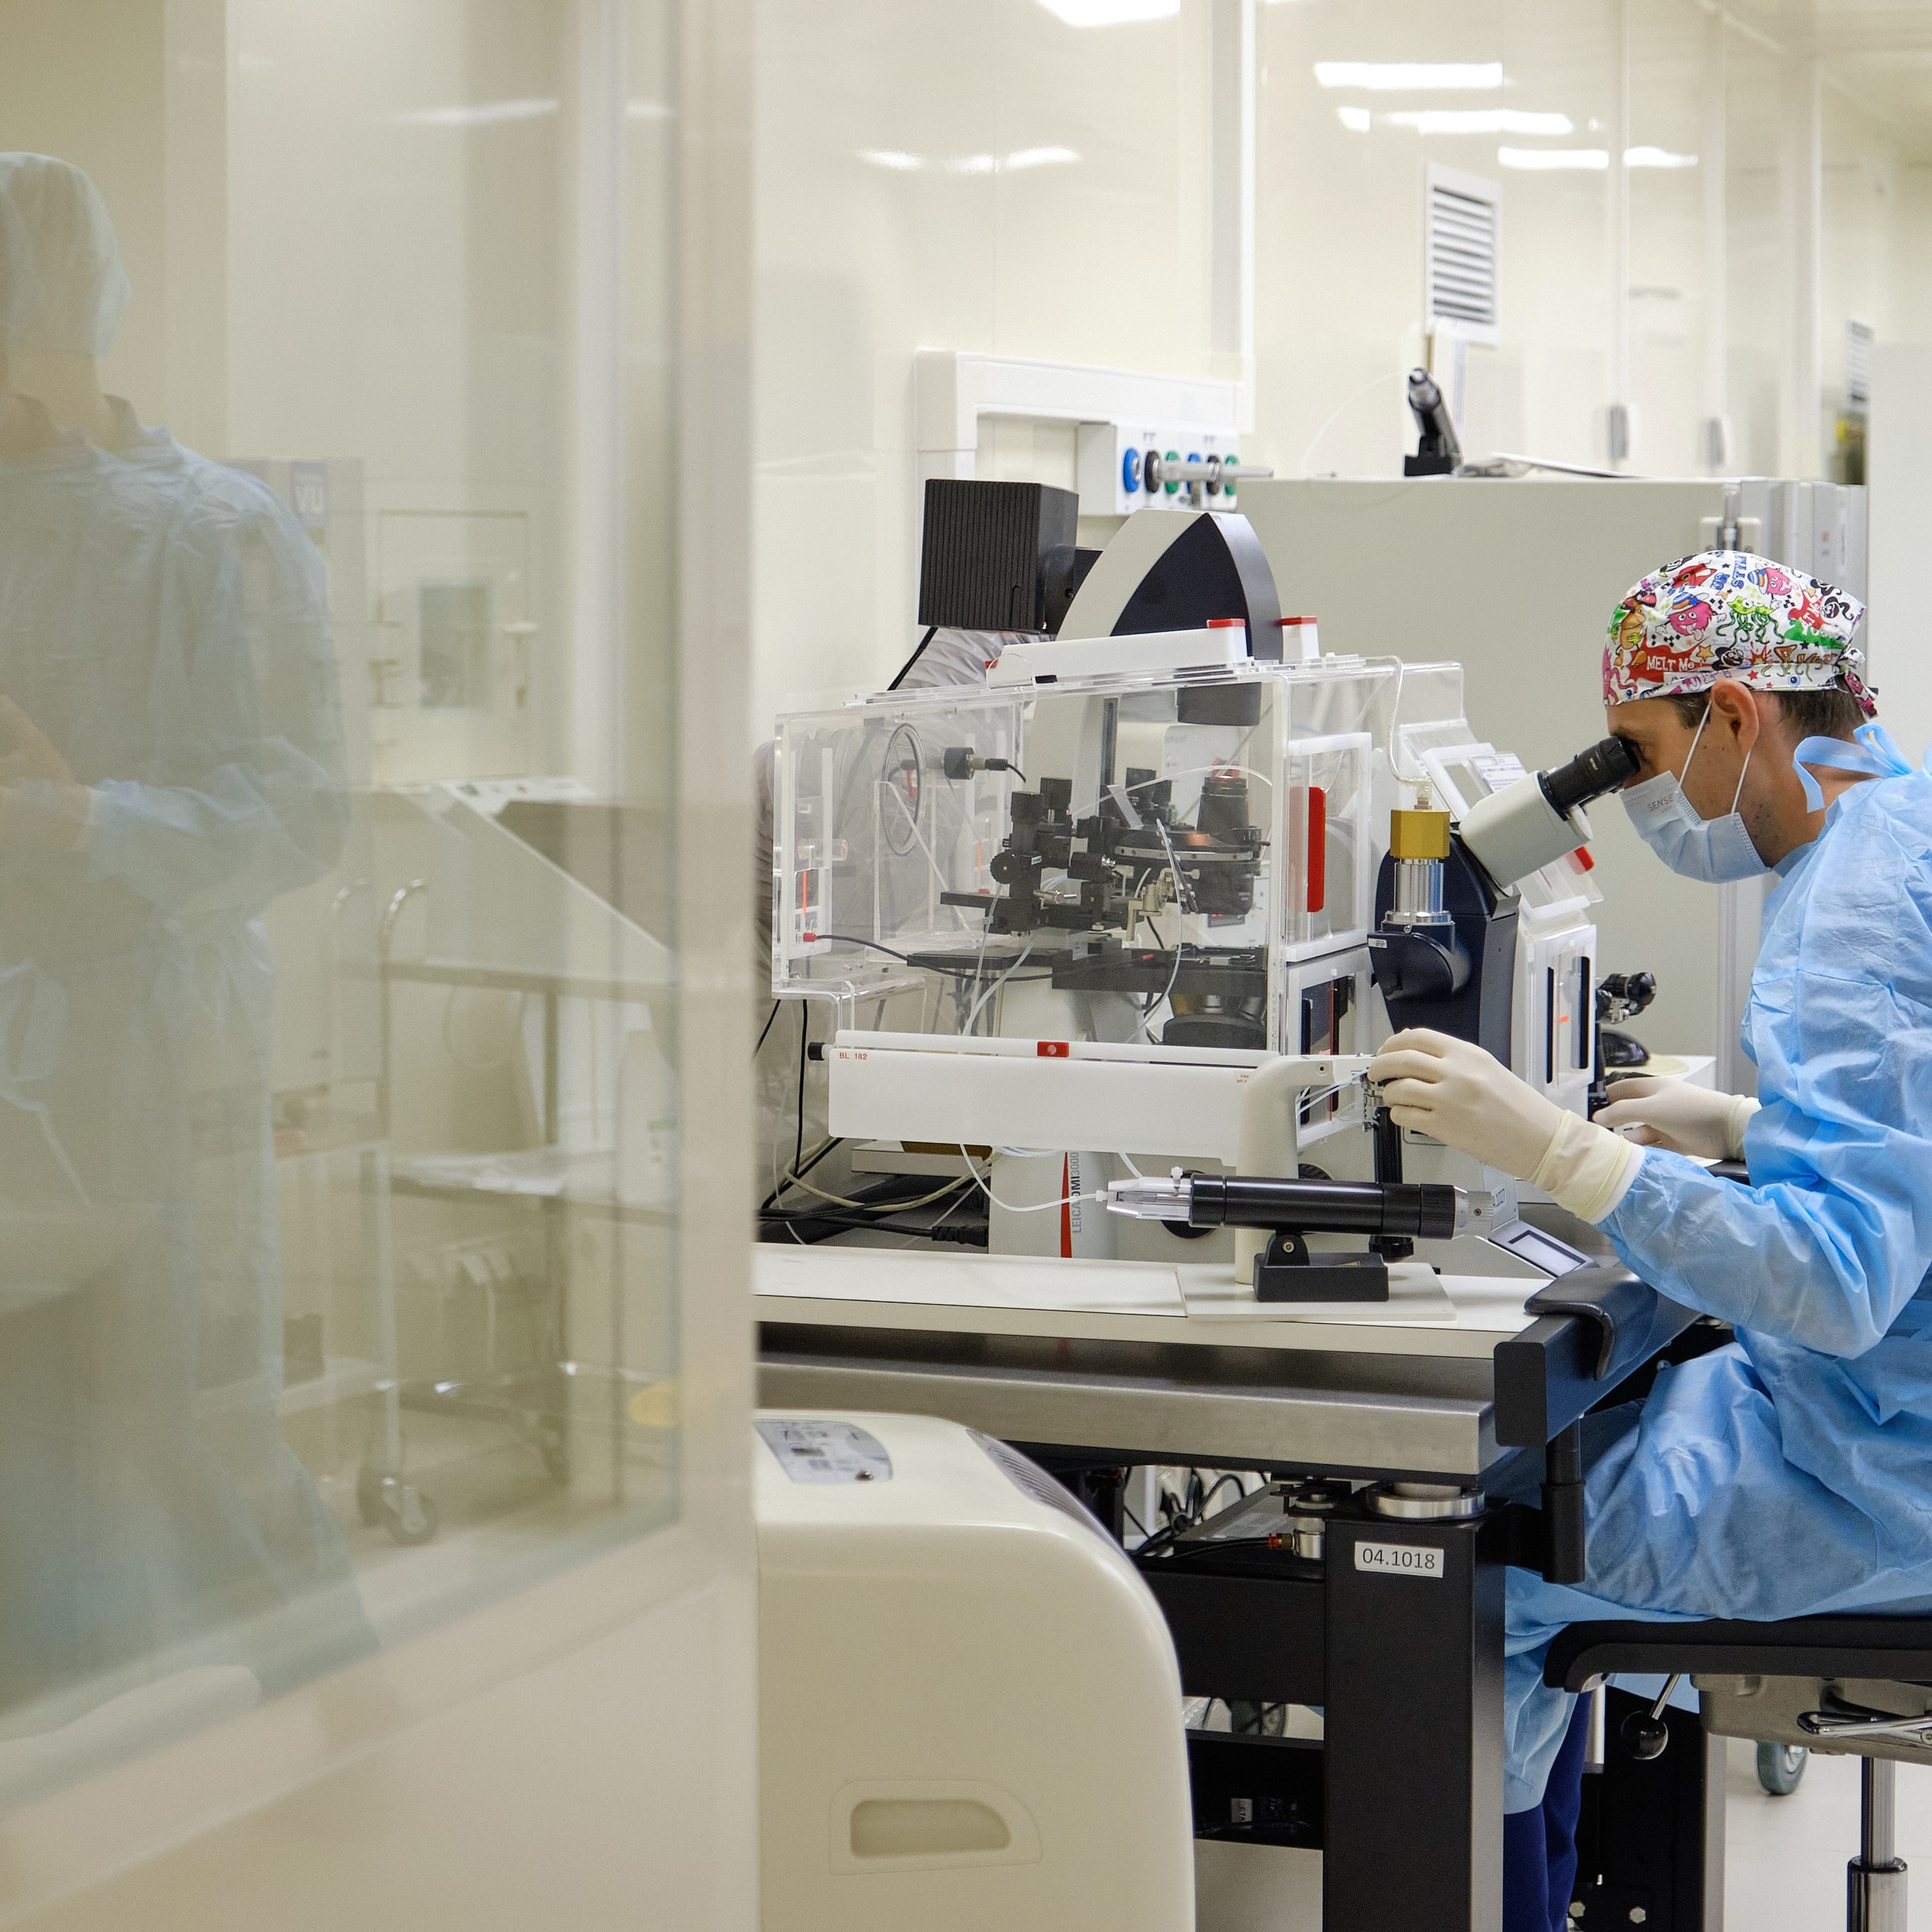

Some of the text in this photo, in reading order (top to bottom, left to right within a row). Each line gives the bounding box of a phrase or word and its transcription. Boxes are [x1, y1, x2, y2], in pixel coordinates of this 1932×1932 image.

[1646, 655, 1676, 672] MELT
[1647, 793, 1675, 812] SENSE
[1362, 1548, 1435, 1569] 04.1018
